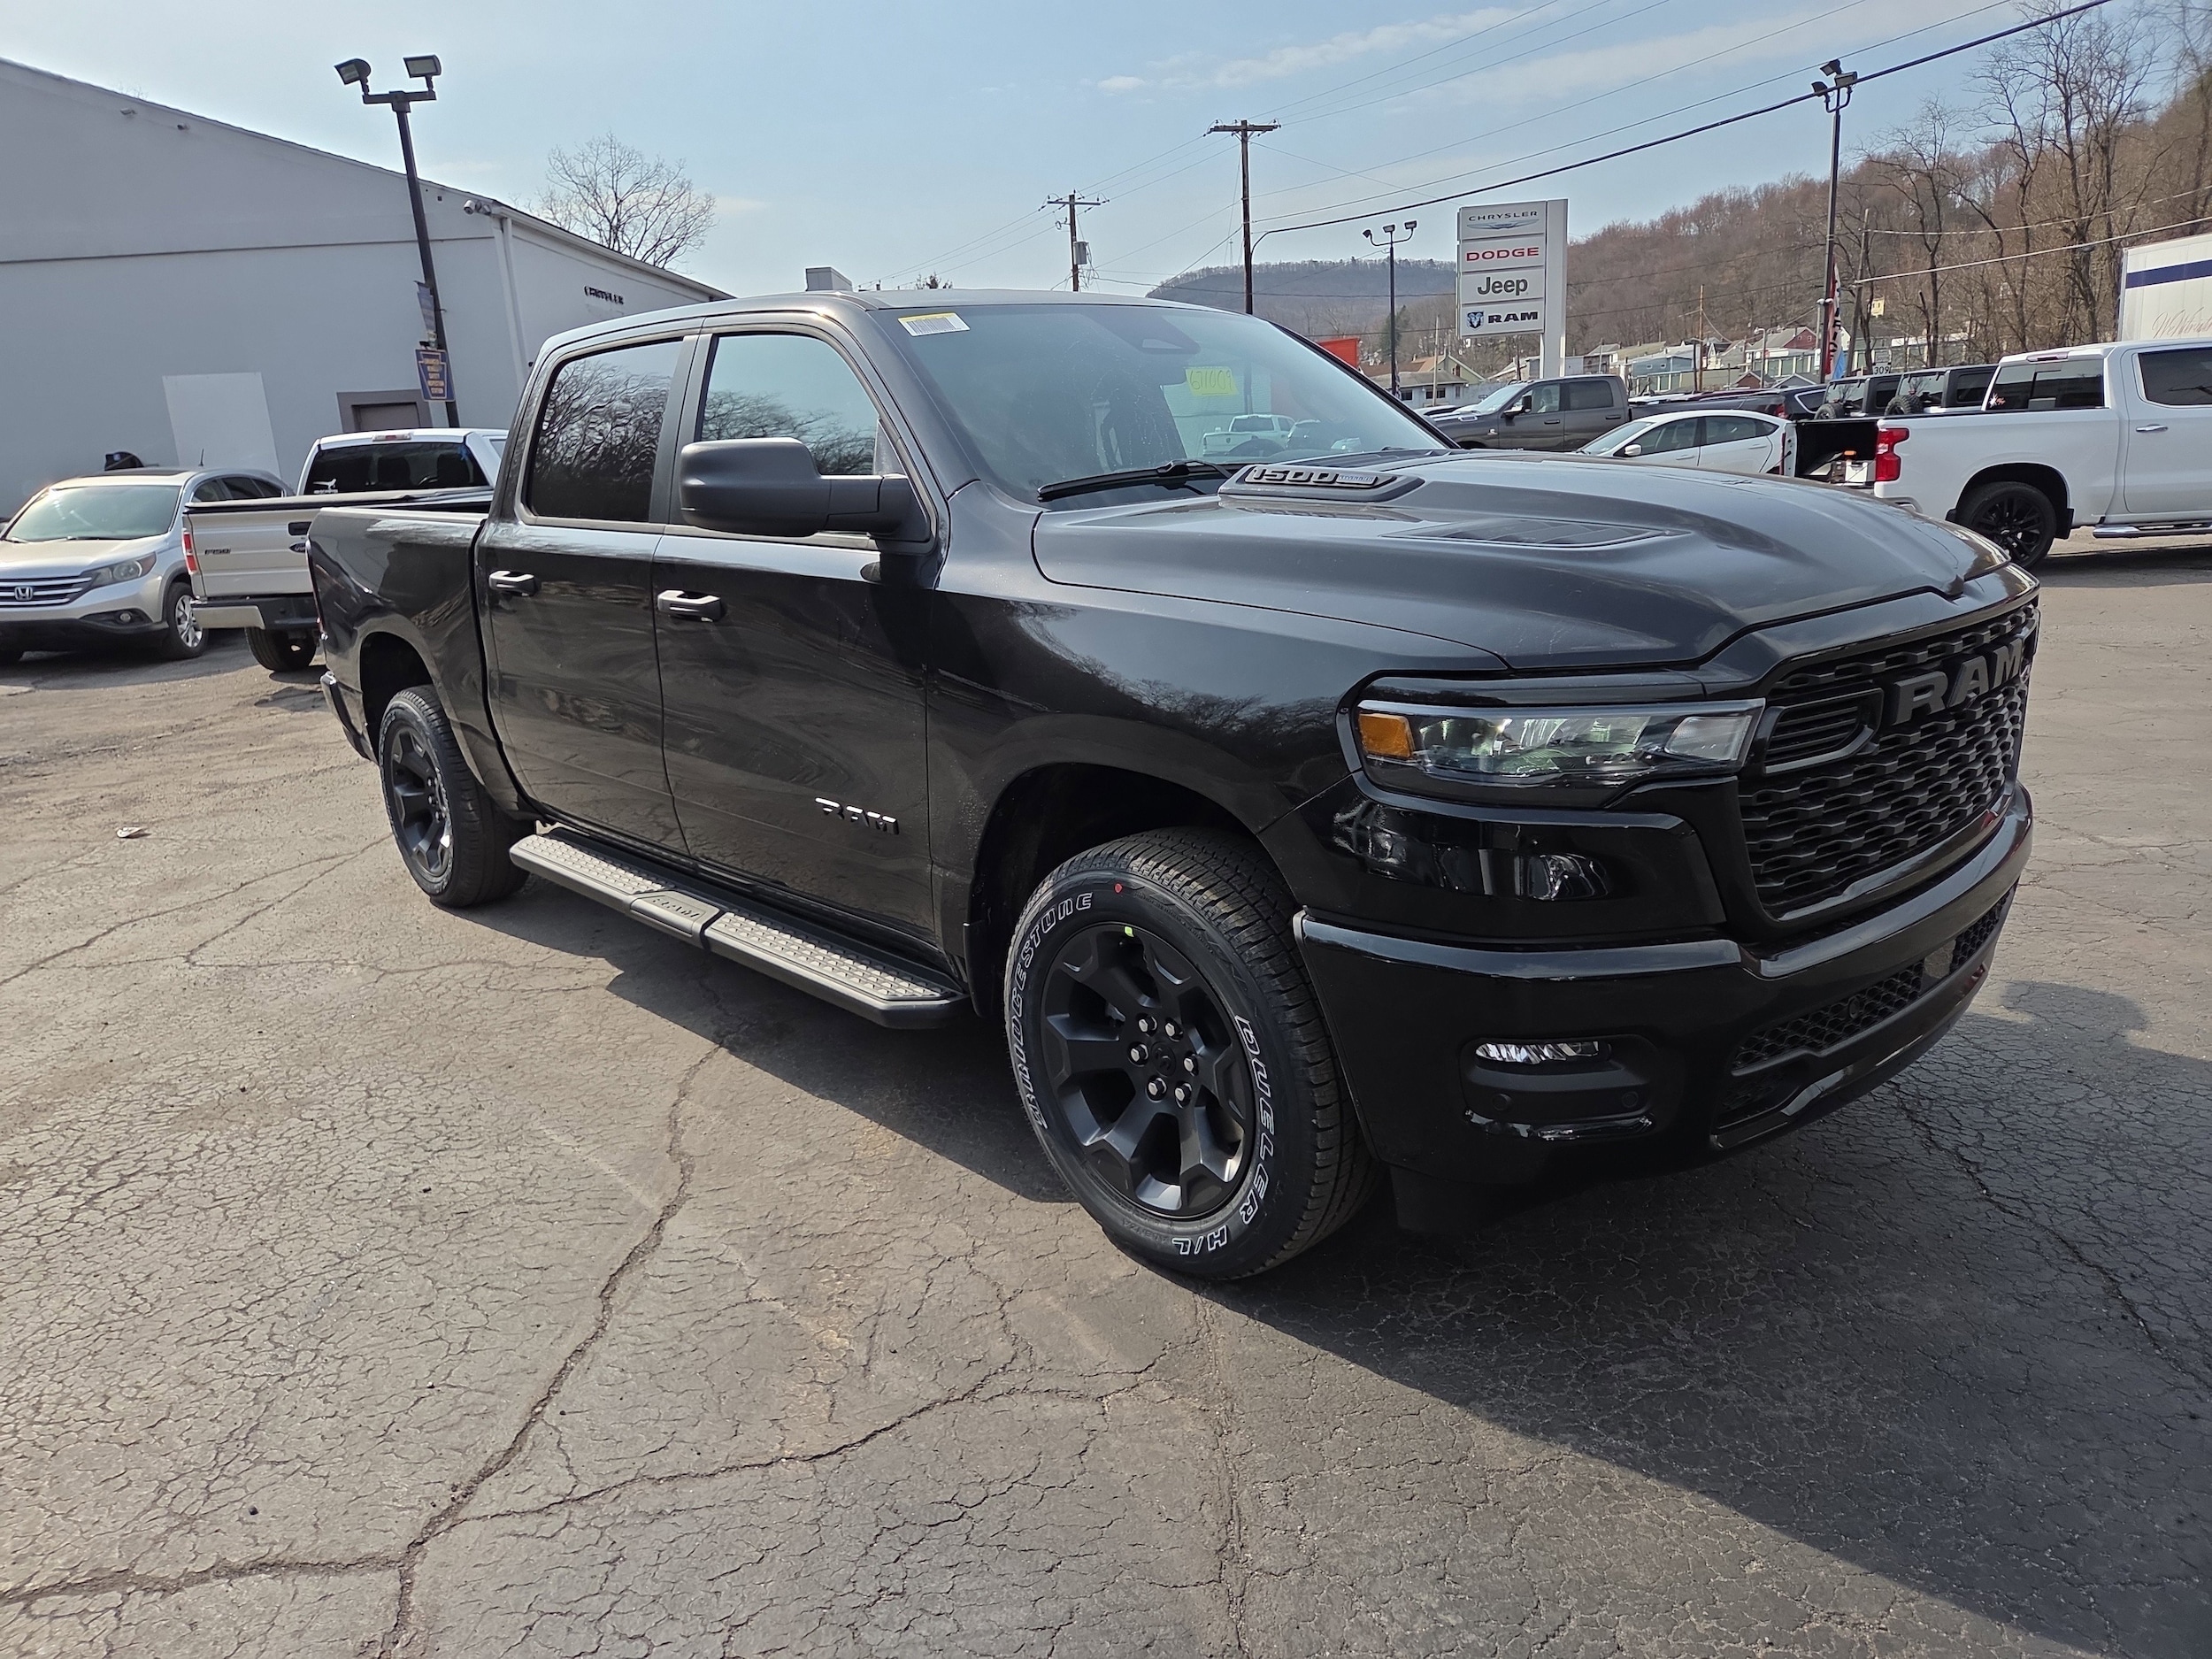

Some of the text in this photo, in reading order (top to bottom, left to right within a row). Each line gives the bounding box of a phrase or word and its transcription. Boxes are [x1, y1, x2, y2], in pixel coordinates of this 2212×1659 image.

[1468, 211, 1539, 222] CHRYSLER
[1466, 247, 1540, 262] DODGE
[1477, 276, 1528, 296] Jeep
[1487, 311, 1539, 324] RAM
[1874, 365, 1890, 374] 309
[1253, 468, 1340, 484] 1500
[1893, 637, 2024, 726] RAM
[815, 797, 900, 835] RAM
[1011, 892, 1094, 1130] BRIDGESTONE
[1171, 1015, 1275, 1256] DUELER H/L
